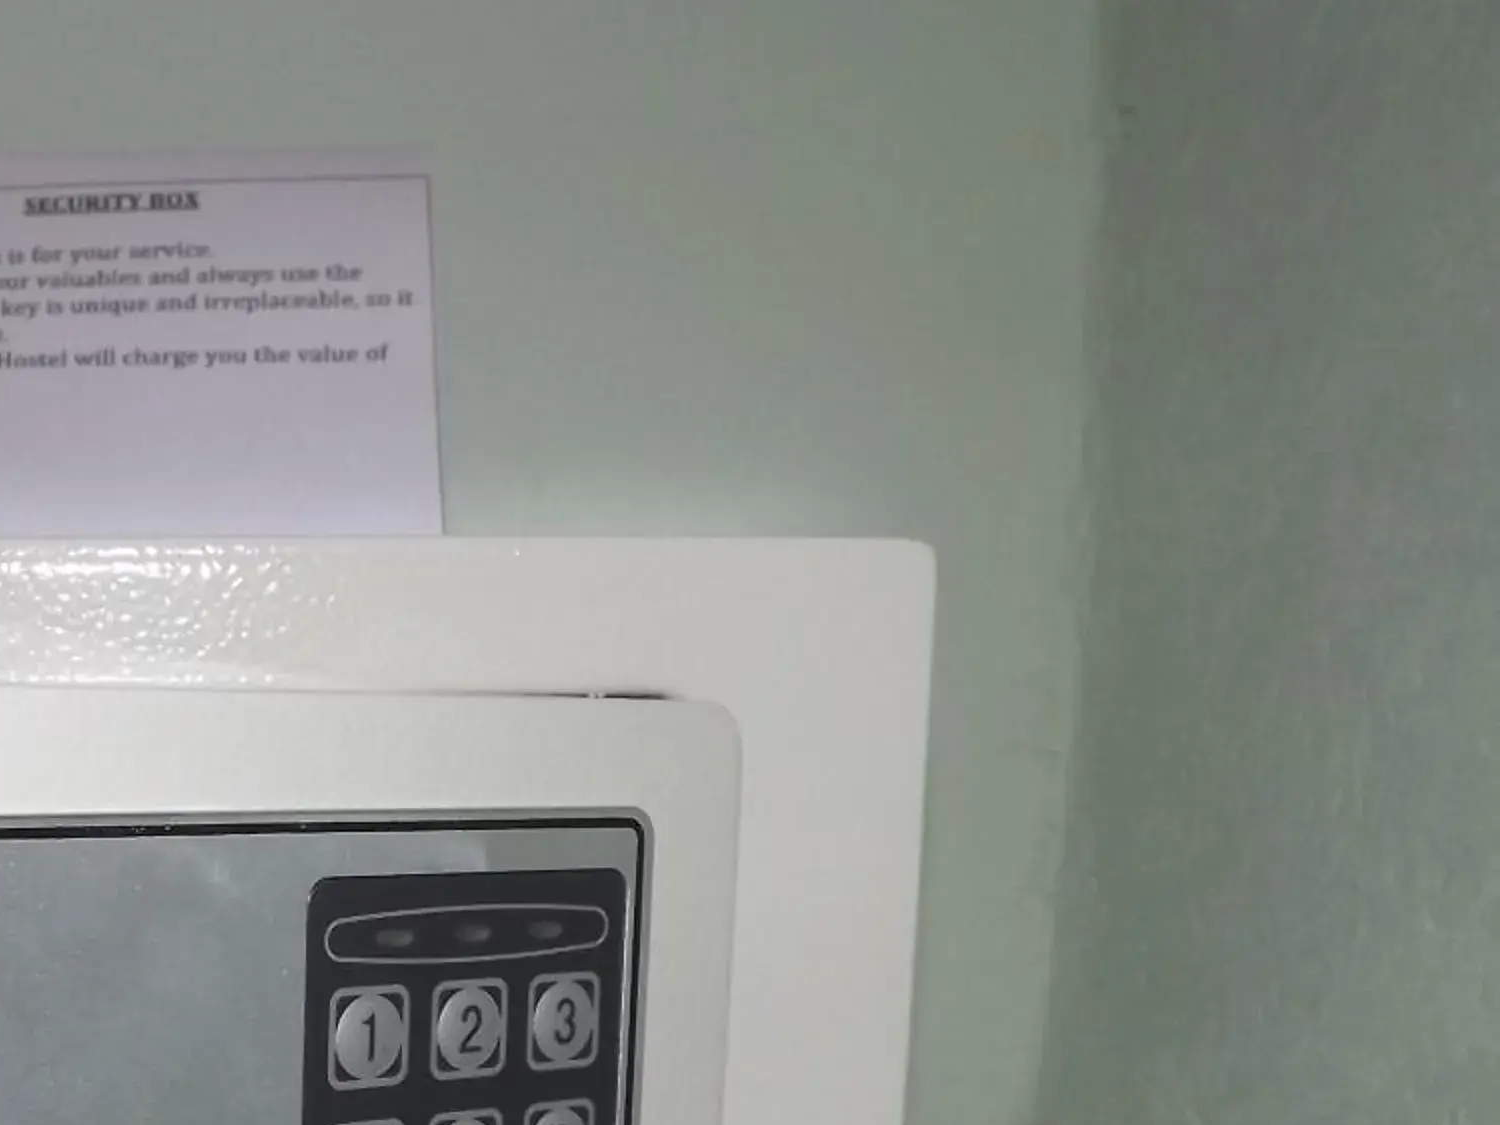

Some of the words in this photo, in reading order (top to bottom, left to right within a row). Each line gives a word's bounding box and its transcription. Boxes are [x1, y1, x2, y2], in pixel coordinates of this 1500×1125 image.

[22, 193, 143, 217] SECURITY
[148, 191, 200, 212] BOX
[7, 249, 25, 265] is
[30, 246, 62, 263] for
[70, 247, 121, 266] your
[36, 270, 140, 289] valuables
[148, 268, 190, 285] and
[196, 266, 274, 286] always
[280, 267, 318, 281] use
[325, 264, 362, 281] the
[1, 299, 41, 318] key
[46, 299, 63, 315] is
[70, 299, 148, 316] unique
[155, 294, 197, 312] and
[366, 296, 392, 308] so
[396, 290, 414, 307] it
[73, 348, 116, 366] will
[122, 346, 199, 368] charge
[204, 349, 247, 368] you
[253, 345, 291, 363] the
[296, 344, 358, 363] value
[365, 342, 390, 361] of
[362, 1012, 377, 1063] 1
[459, 1005, 482, 1054] 2
[555, 997, 576, 1044] 3
